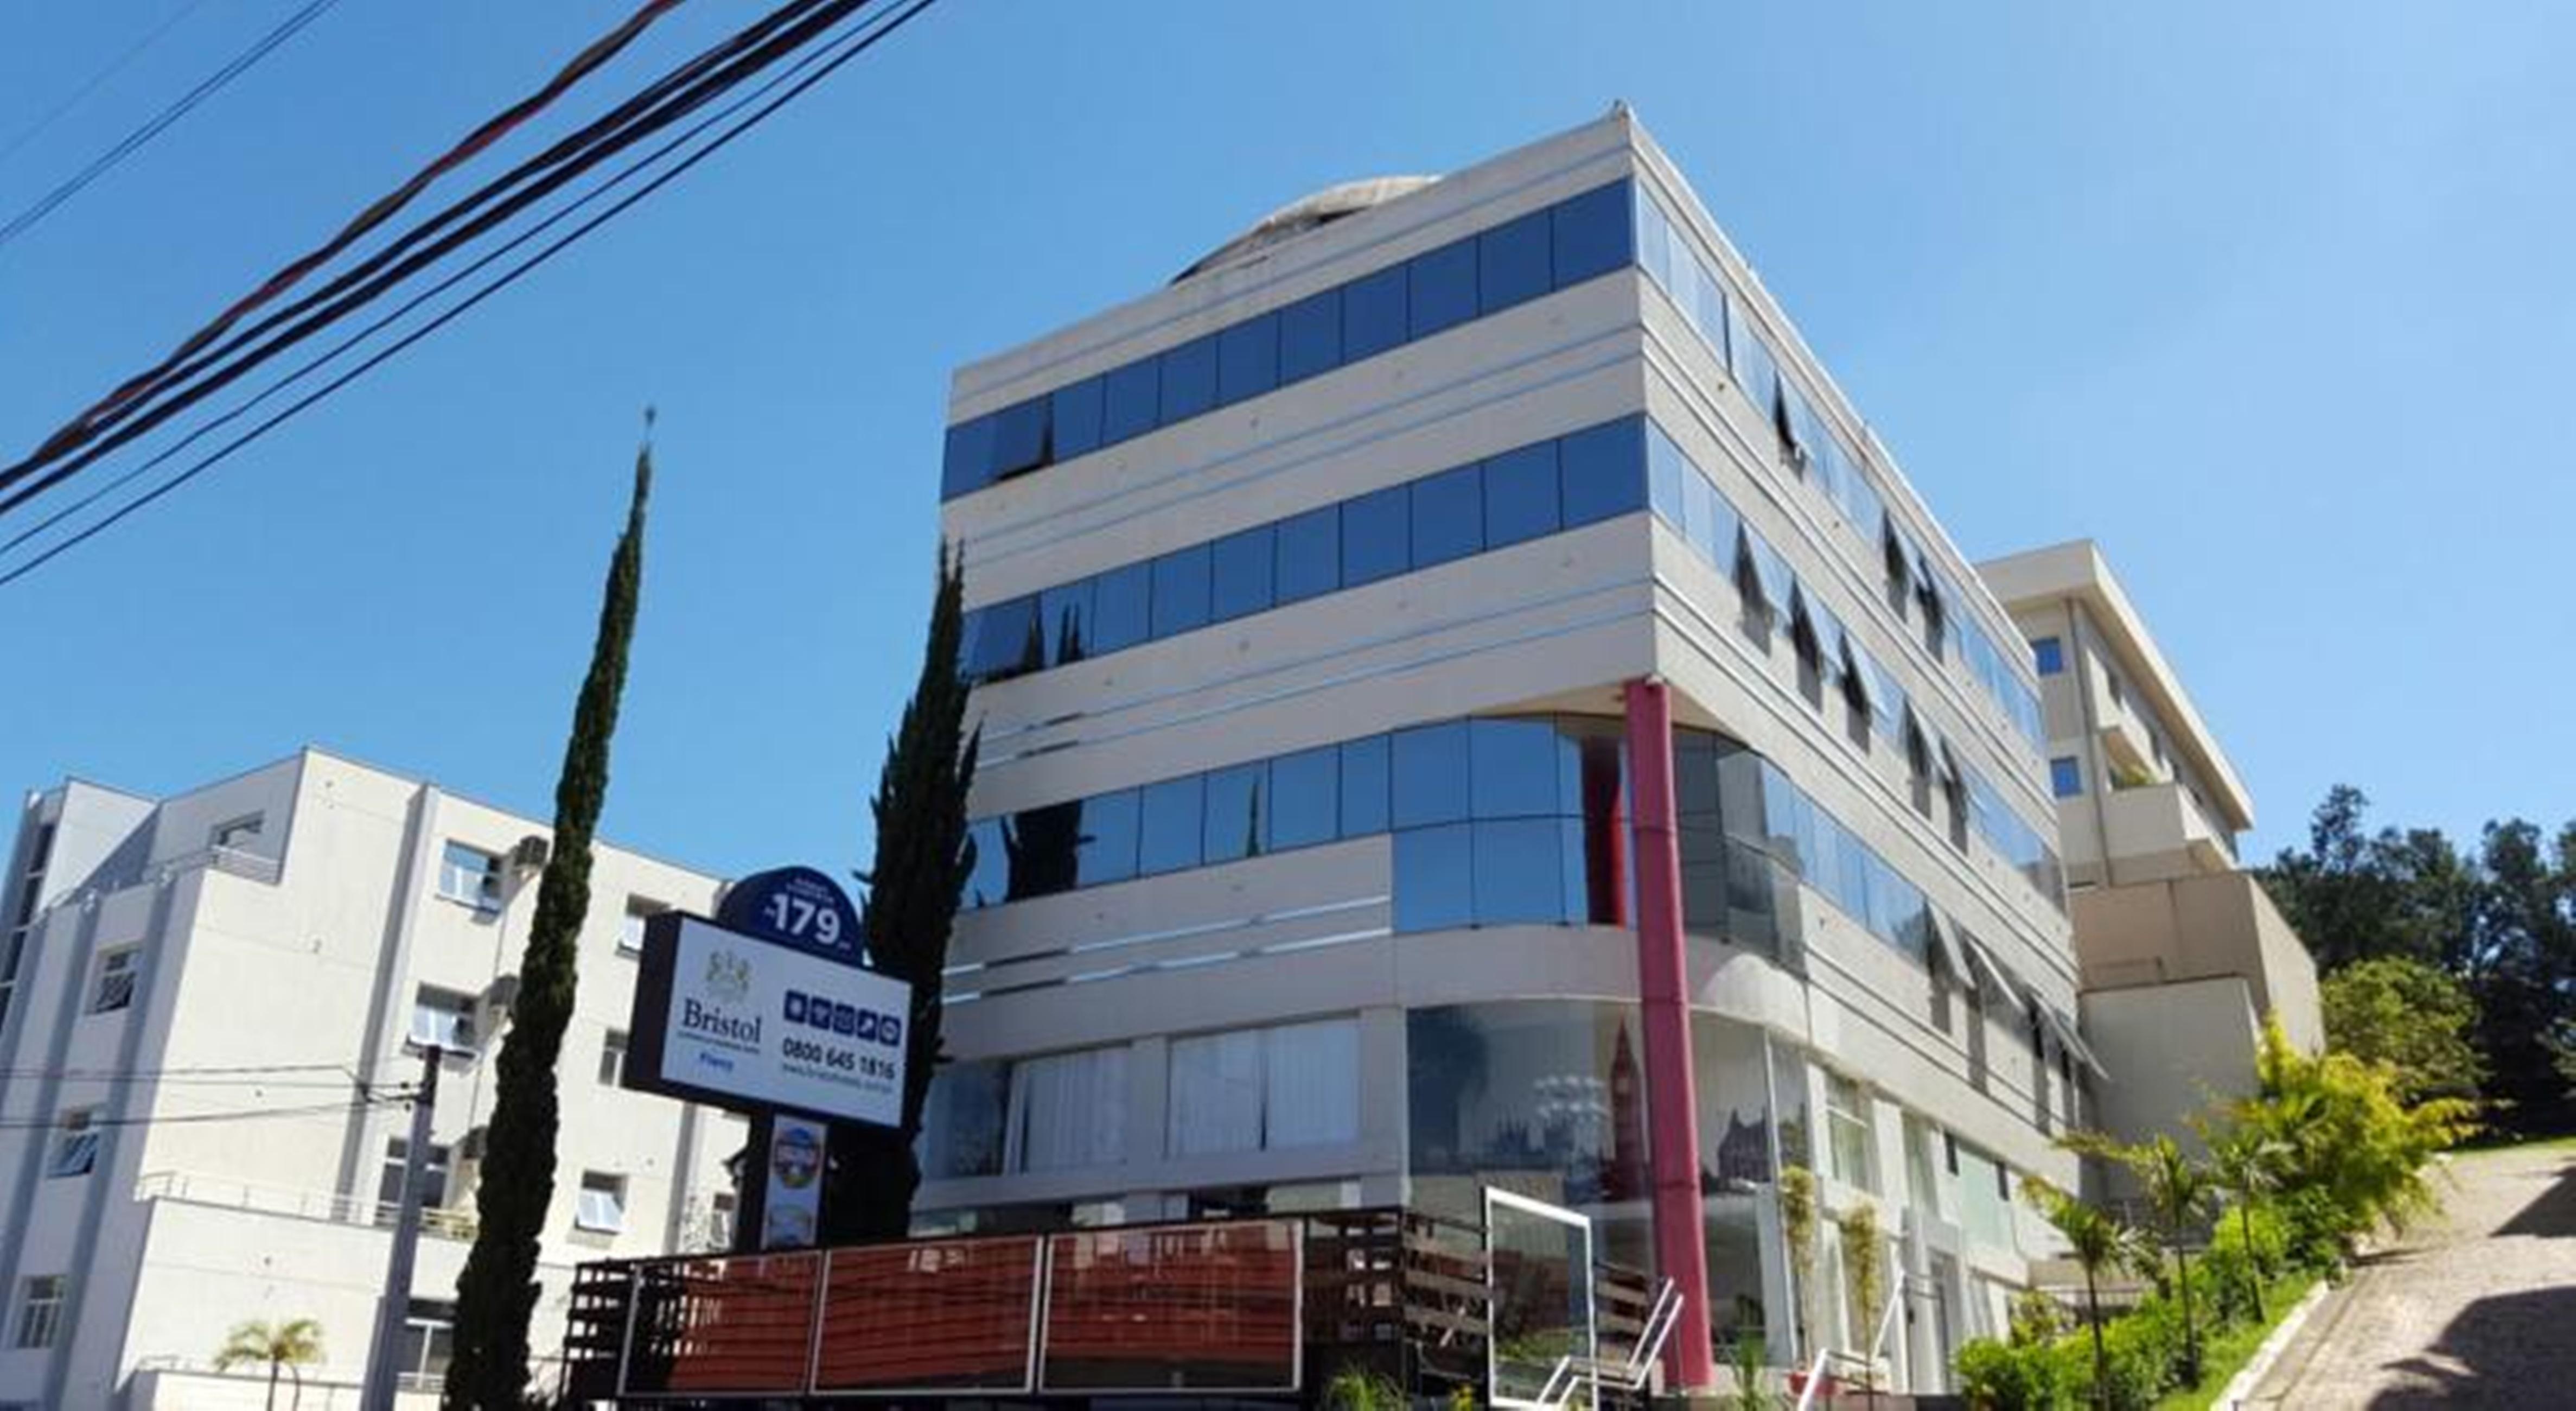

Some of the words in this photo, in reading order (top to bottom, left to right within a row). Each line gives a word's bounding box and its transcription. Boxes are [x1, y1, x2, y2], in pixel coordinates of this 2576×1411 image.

[773, 893, 840, 945] 179
[683, 999, 761, 1044] Bristol
[782, 1037, 821, 1063] 0800
[826, 1047, 855, 1071] 645
